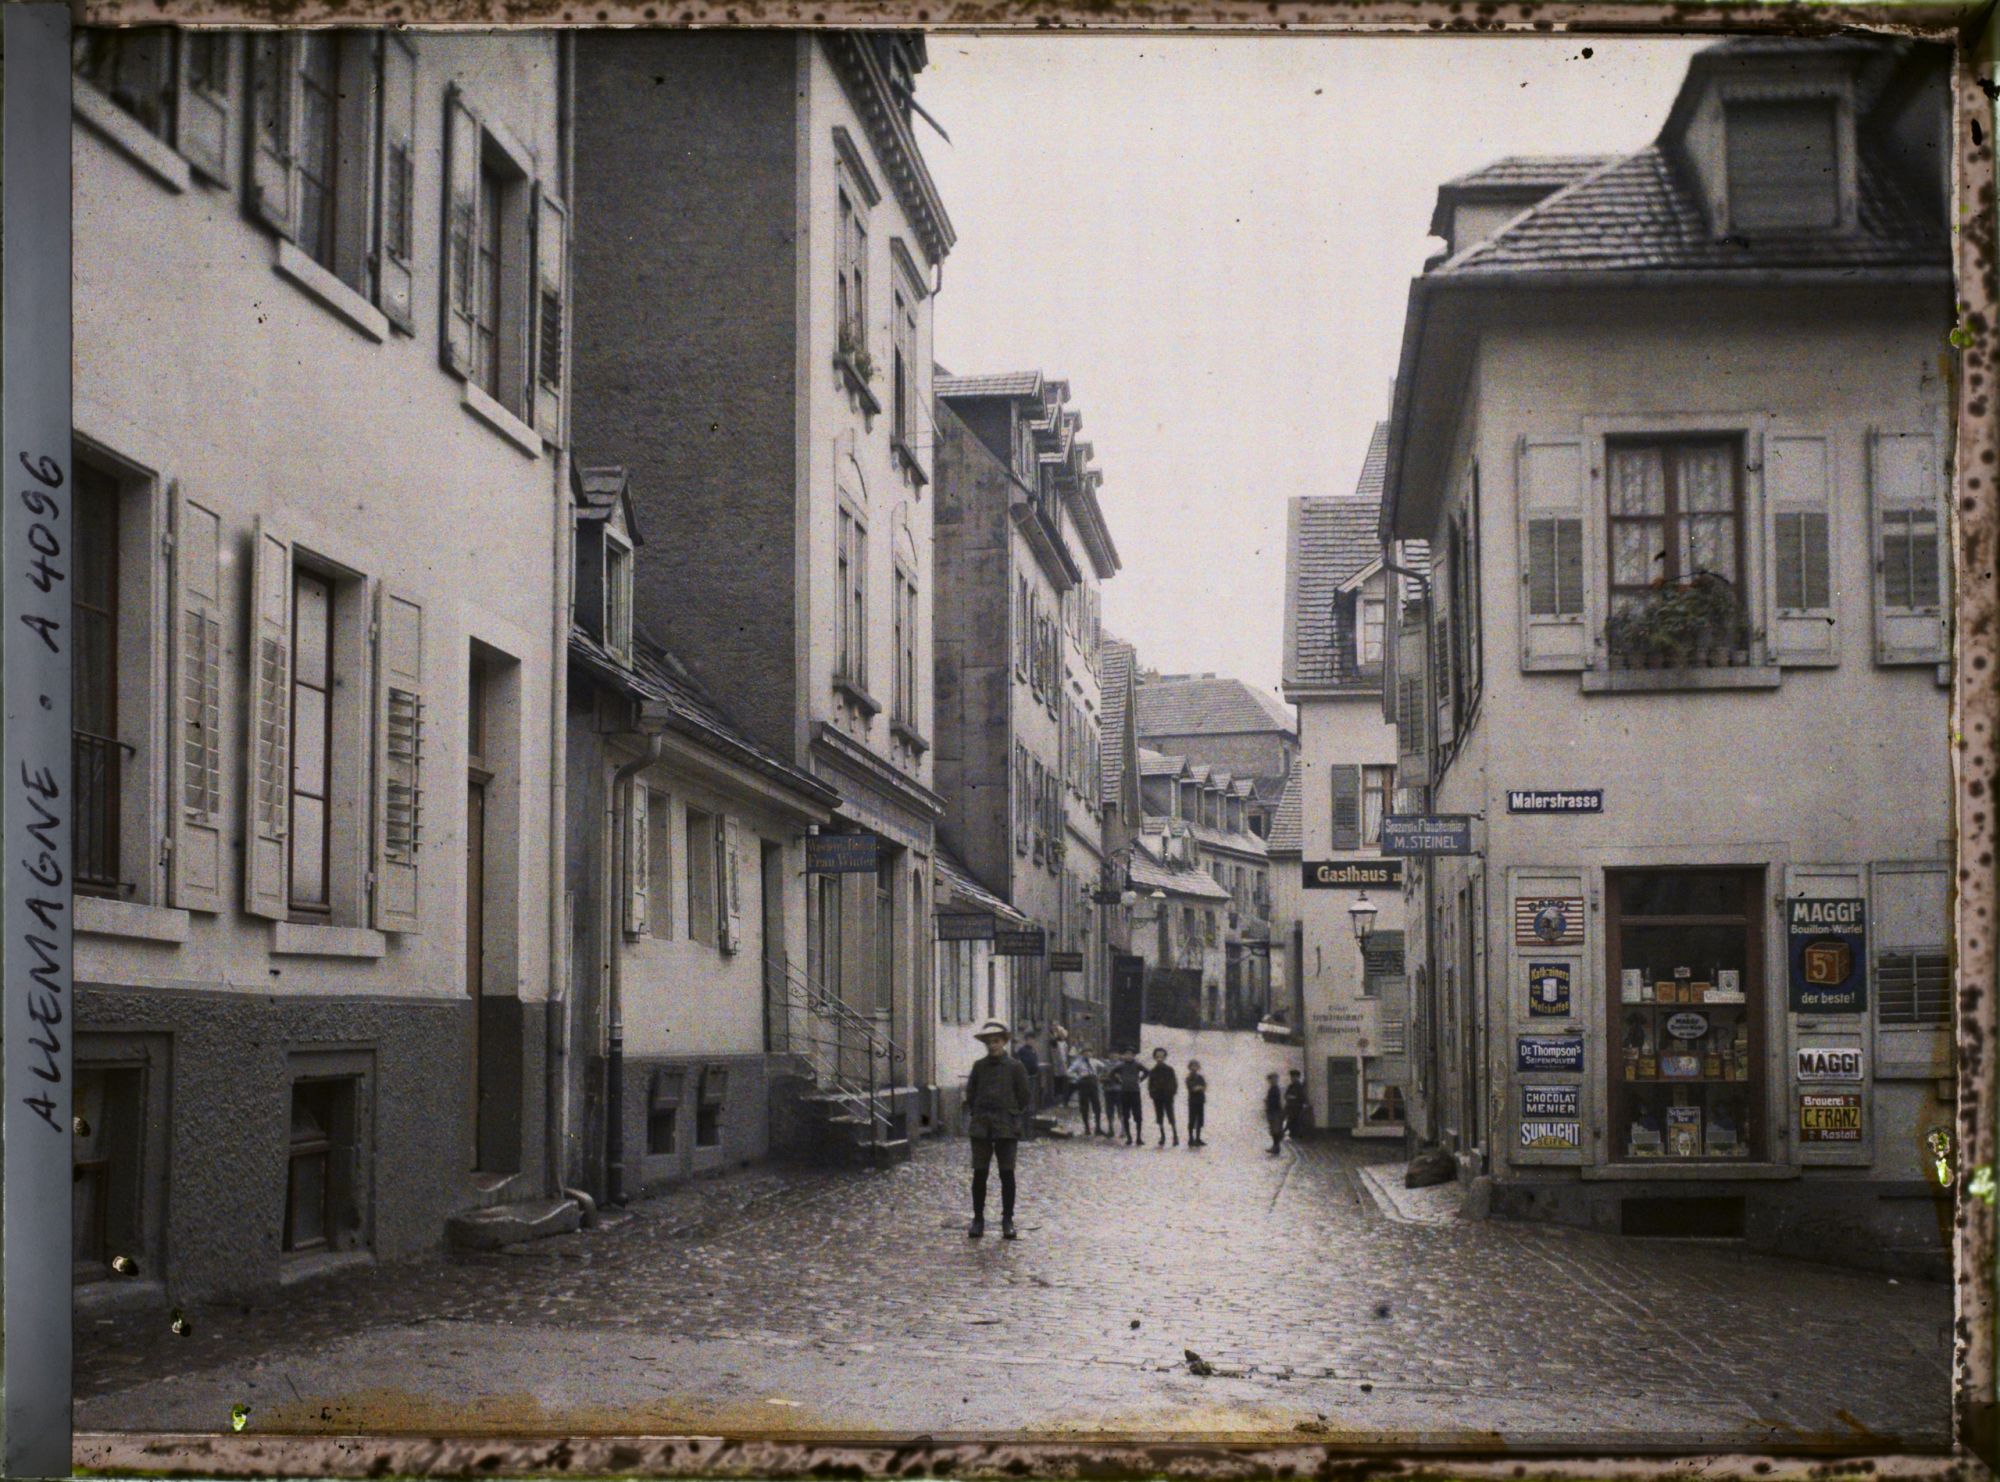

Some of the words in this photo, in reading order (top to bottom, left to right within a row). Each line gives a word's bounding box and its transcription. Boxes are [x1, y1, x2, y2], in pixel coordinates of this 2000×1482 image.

[19, 450, 62, 592] 4096
[20, 615, 61, 652] A
[1317, 865, 1388, 882] Gasthaus
[20, 758, 63, 1133] ALLEMAGNE
[1801, 992, 1818, 1004] der
[1799, 1053, 1859, 1073] MAGGI
[1526, 1093, 1576, 1103] CHOCOLAT
[1526, 1103, 1576, 1114] MENIER
[1521, 1123, 1580, 1145] SUNLICHT
